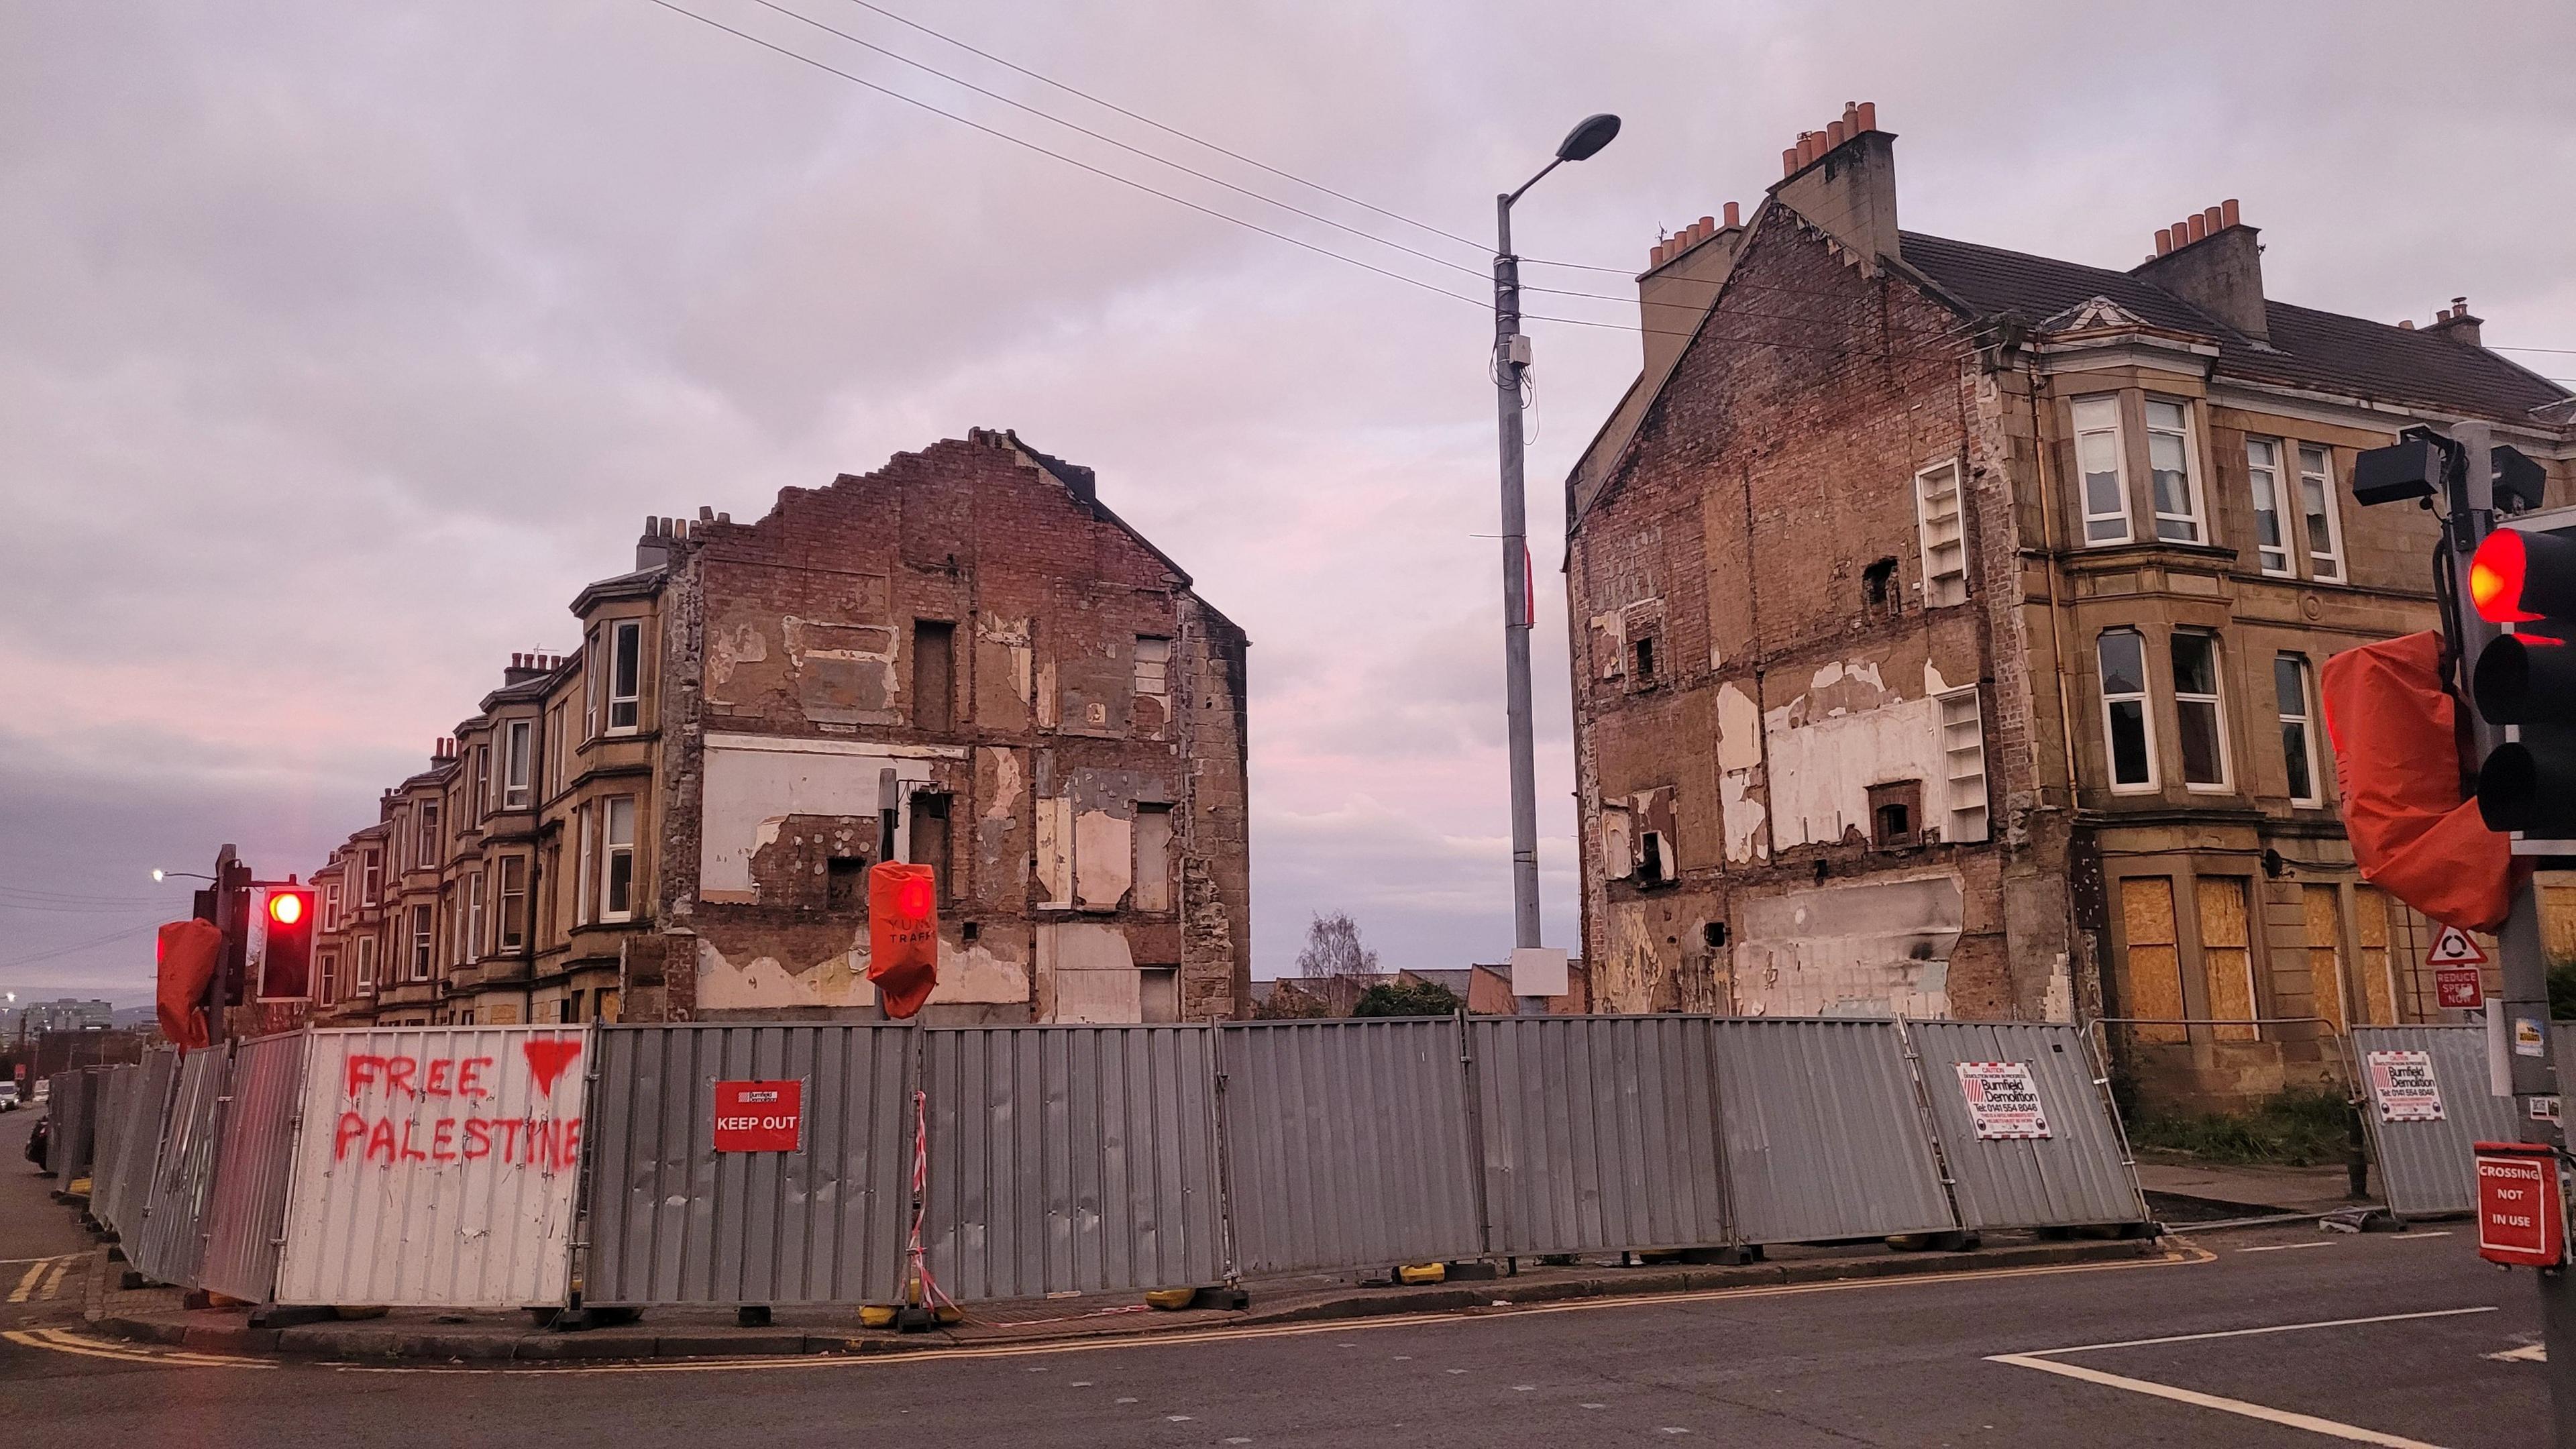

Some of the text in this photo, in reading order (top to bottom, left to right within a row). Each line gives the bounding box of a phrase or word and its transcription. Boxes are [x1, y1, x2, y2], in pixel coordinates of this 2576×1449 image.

[2437, 973, 2476, 982] REDUCE
[347, 1055, 494, 1102] FREE
[2391, 1077, 2436, 1087] Demolition
[1985, 1090, 2038, 1102] Demolition
[1987, 1104, 2002, 1112] 0141
[2002, 1104, 2017, 1112] 554
[2018, 1104, 2037, 1112] 8048
[717, 1116, 797, 1130] KEEP OUT
[335, 1111, 582, 1170] PALESTINE
[2479, 1166, 2539, 1180] CROSSING
[2497, 1189, 2523, 1200] NOT
[2493, 1214, 2530, 1227] IN USE
